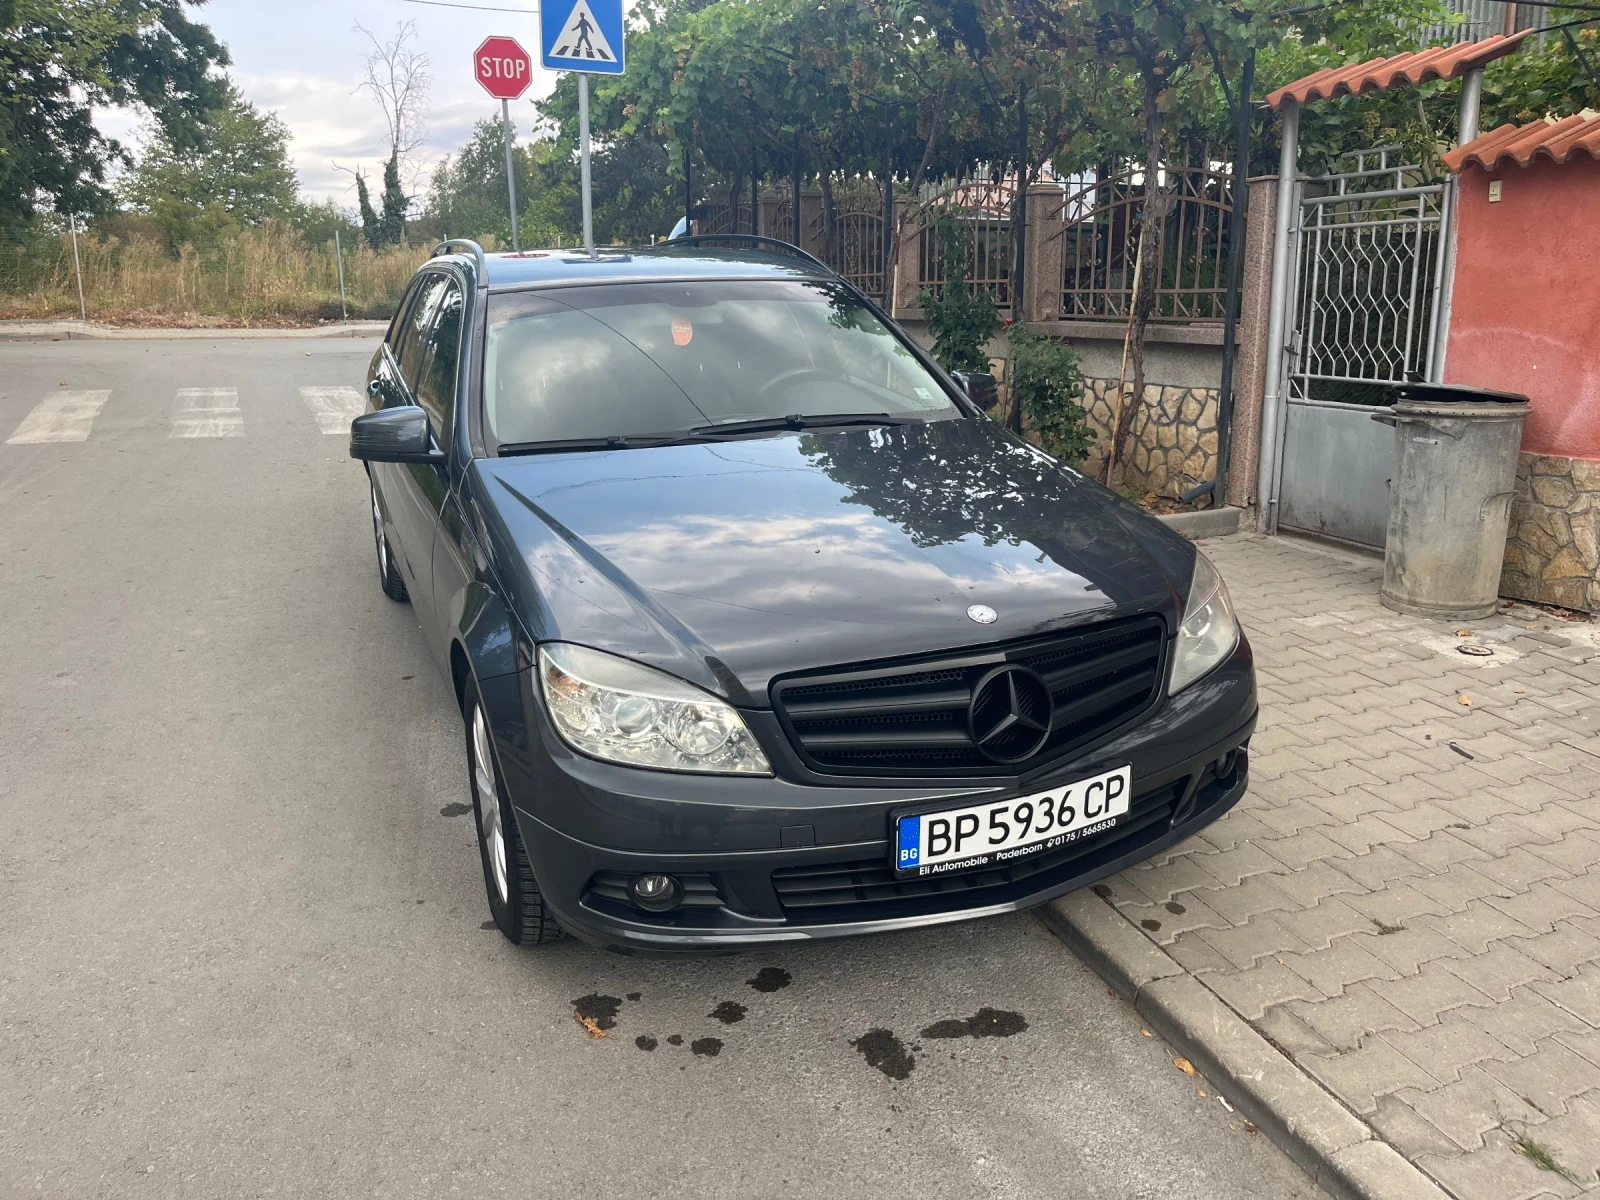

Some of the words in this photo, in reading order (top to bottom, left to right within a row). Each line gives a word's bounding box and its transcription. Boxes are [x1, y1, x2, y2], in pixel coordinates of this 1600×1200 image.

[481, 56, 526, 79] STOP
[927, 813, 980, 858] BP
[988, 790, 1076, 845] 5936
[1083, 774, 1125, 820] CP
[900, 848, 918, 861] BG
[919, 866, 930, 876] Eli
[932, 856, 989, 874] Automobile
[996, 843, 1043, 861] Paderborn
[1055, 832, 1076, 846] 0175
[1082, 818, 1117, 838] 5665530
